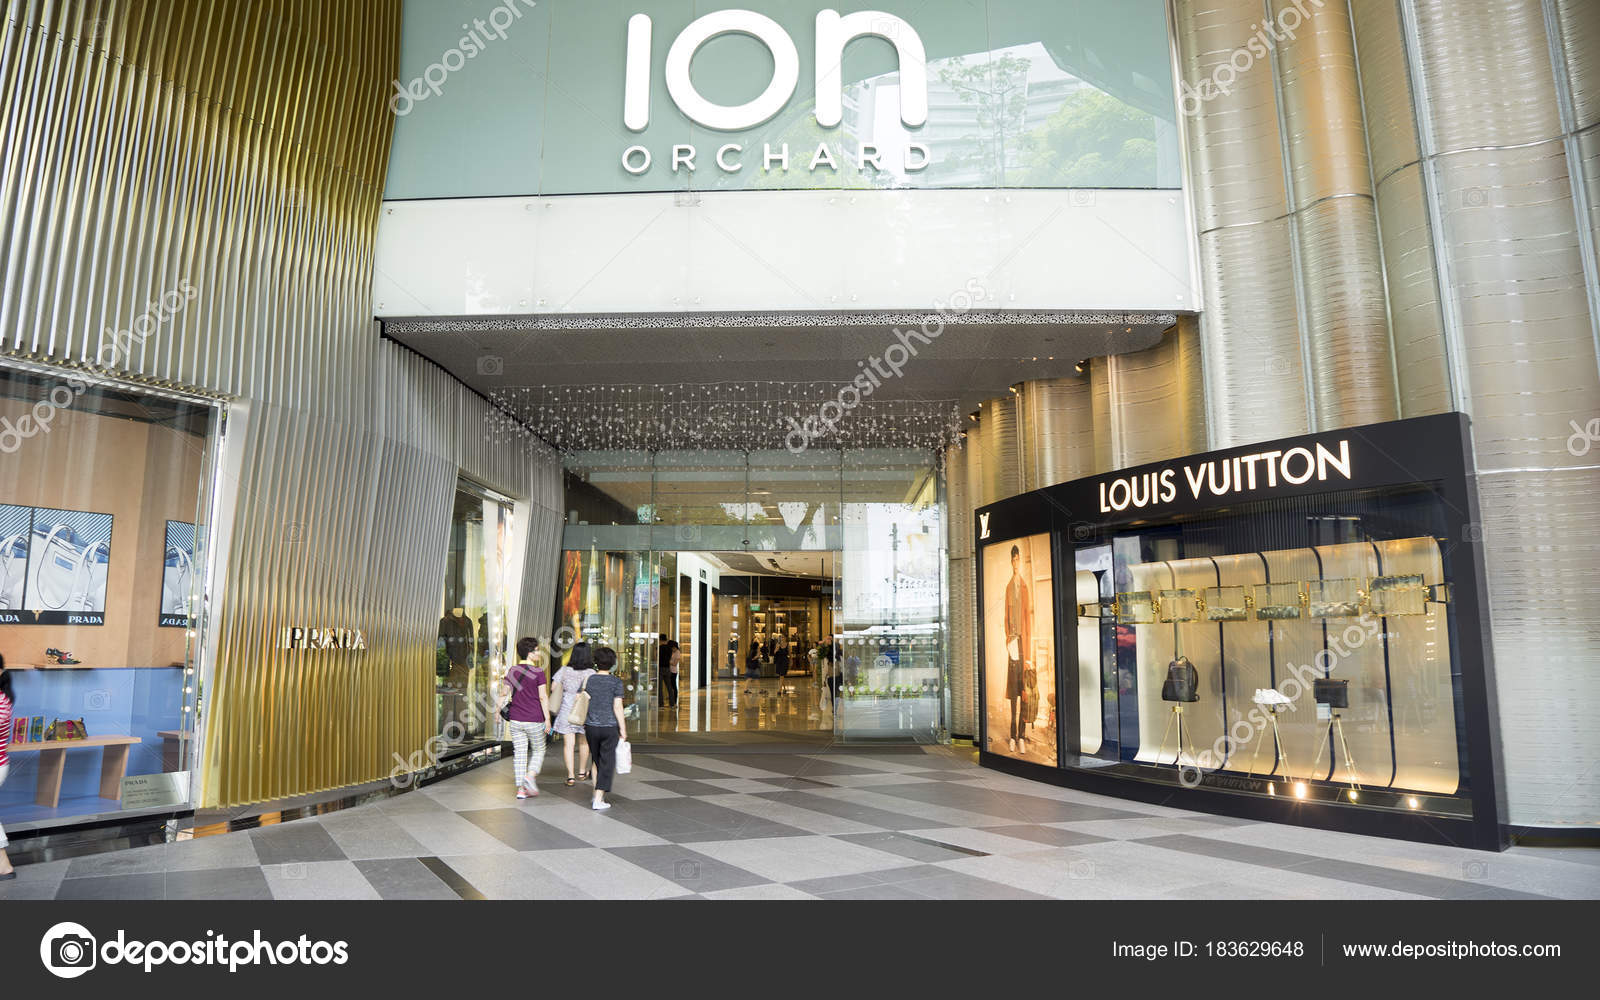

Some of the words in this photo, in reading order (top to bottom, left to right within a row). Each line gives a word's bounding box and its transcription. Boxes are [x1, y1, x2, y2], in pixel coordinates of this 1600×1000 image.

[622, 143, 930, 174] ORCHARD
[1100, 468, 1176, 513] LOUIS
[1184, 440, 1351, 500] VUITTON
[68, 615, 103, 624] PRADA
[287, 627, 368, 649] PRADA
